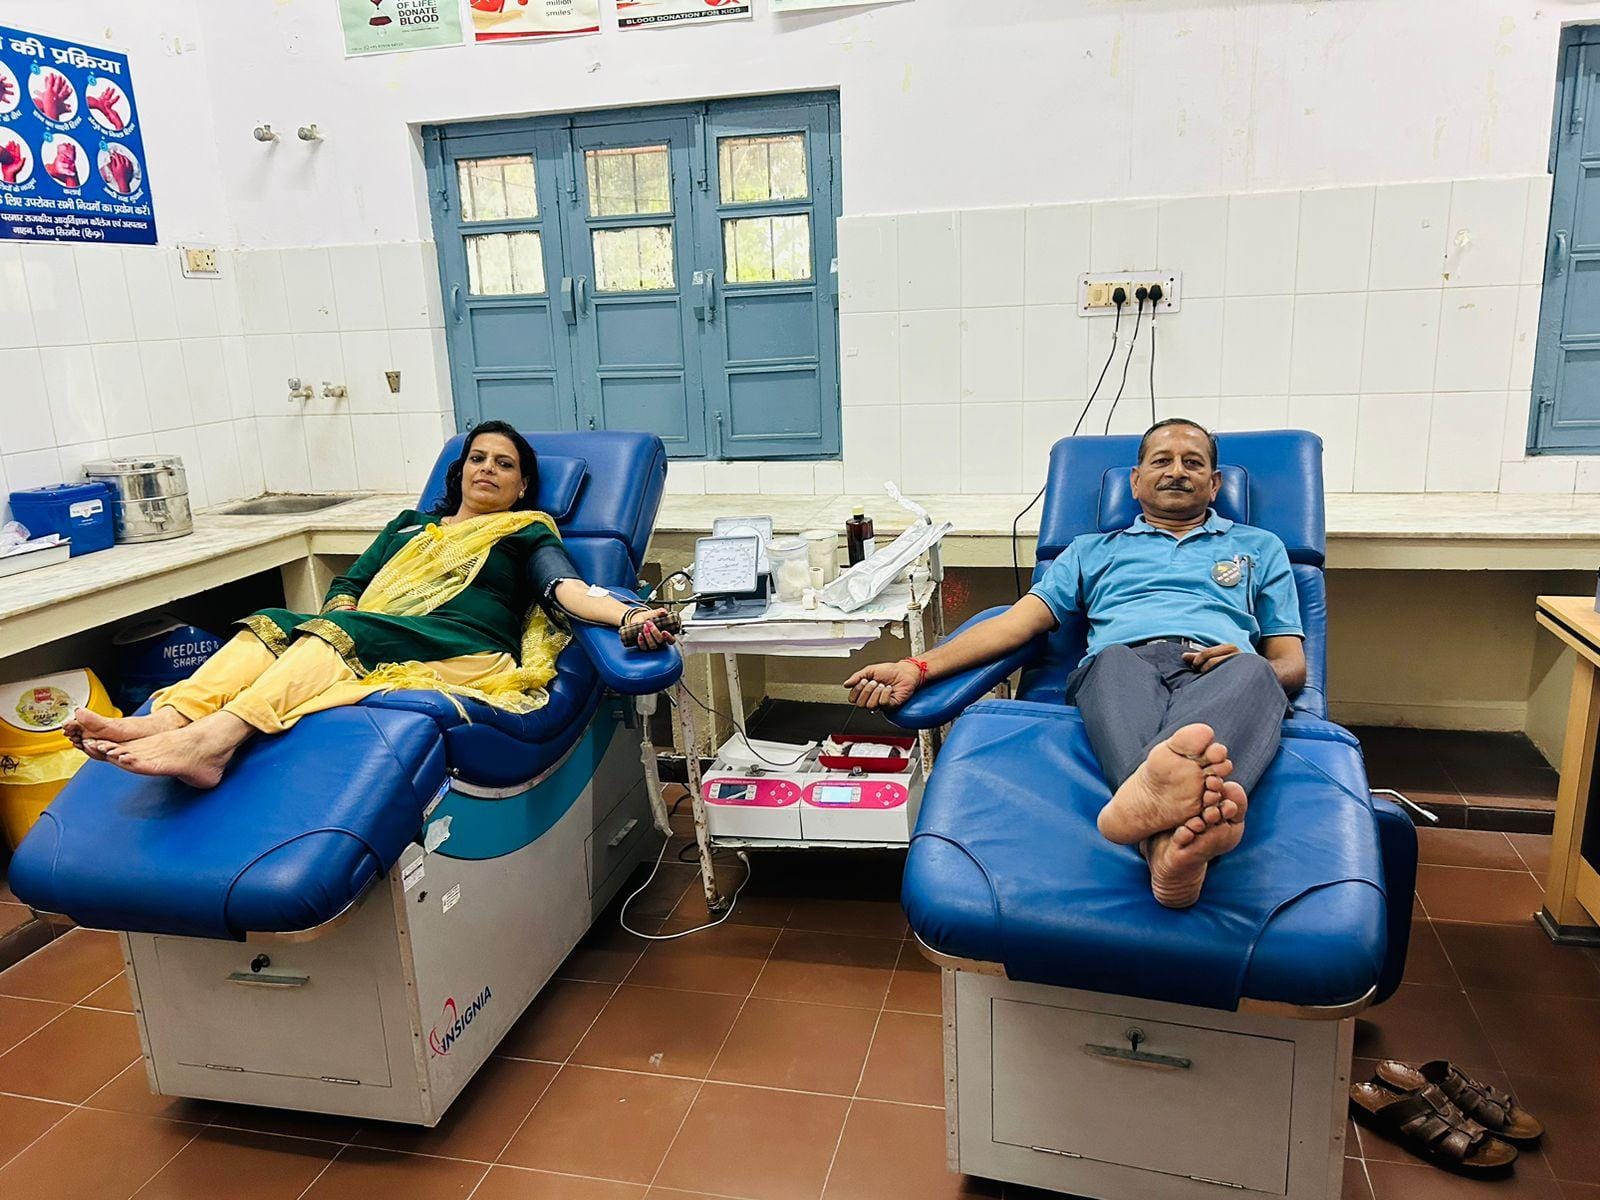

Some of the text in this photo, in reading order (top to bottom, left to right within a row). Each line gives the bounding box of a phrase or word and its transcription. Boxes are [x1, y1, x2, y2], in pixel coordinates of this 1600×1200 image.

[397, 2, 409, 10] OF
[398, 7, 438, 17] DONATE
[400, 14, 439, 26] BLOOD
[626, 16, 656, 25] BLOOD
[657, 12, 700, 21] DONATION
[8, 37, 46, 58] की
[50, 47, 121, 74] प्रक्रिया
[4, 193, 23, 207] लिए
[24, 196, 56, 209] उपरोक्त
[57, 198, 74, 210] सभी
[76, 199, 101, 211] नियमों
[101, 203, 113, 212] का
[113, 202, 134, 214] प्रयोग
[163, 640, 212, 659] NEEDLES
[440, 985, 492, 1053] INSIGNIA
